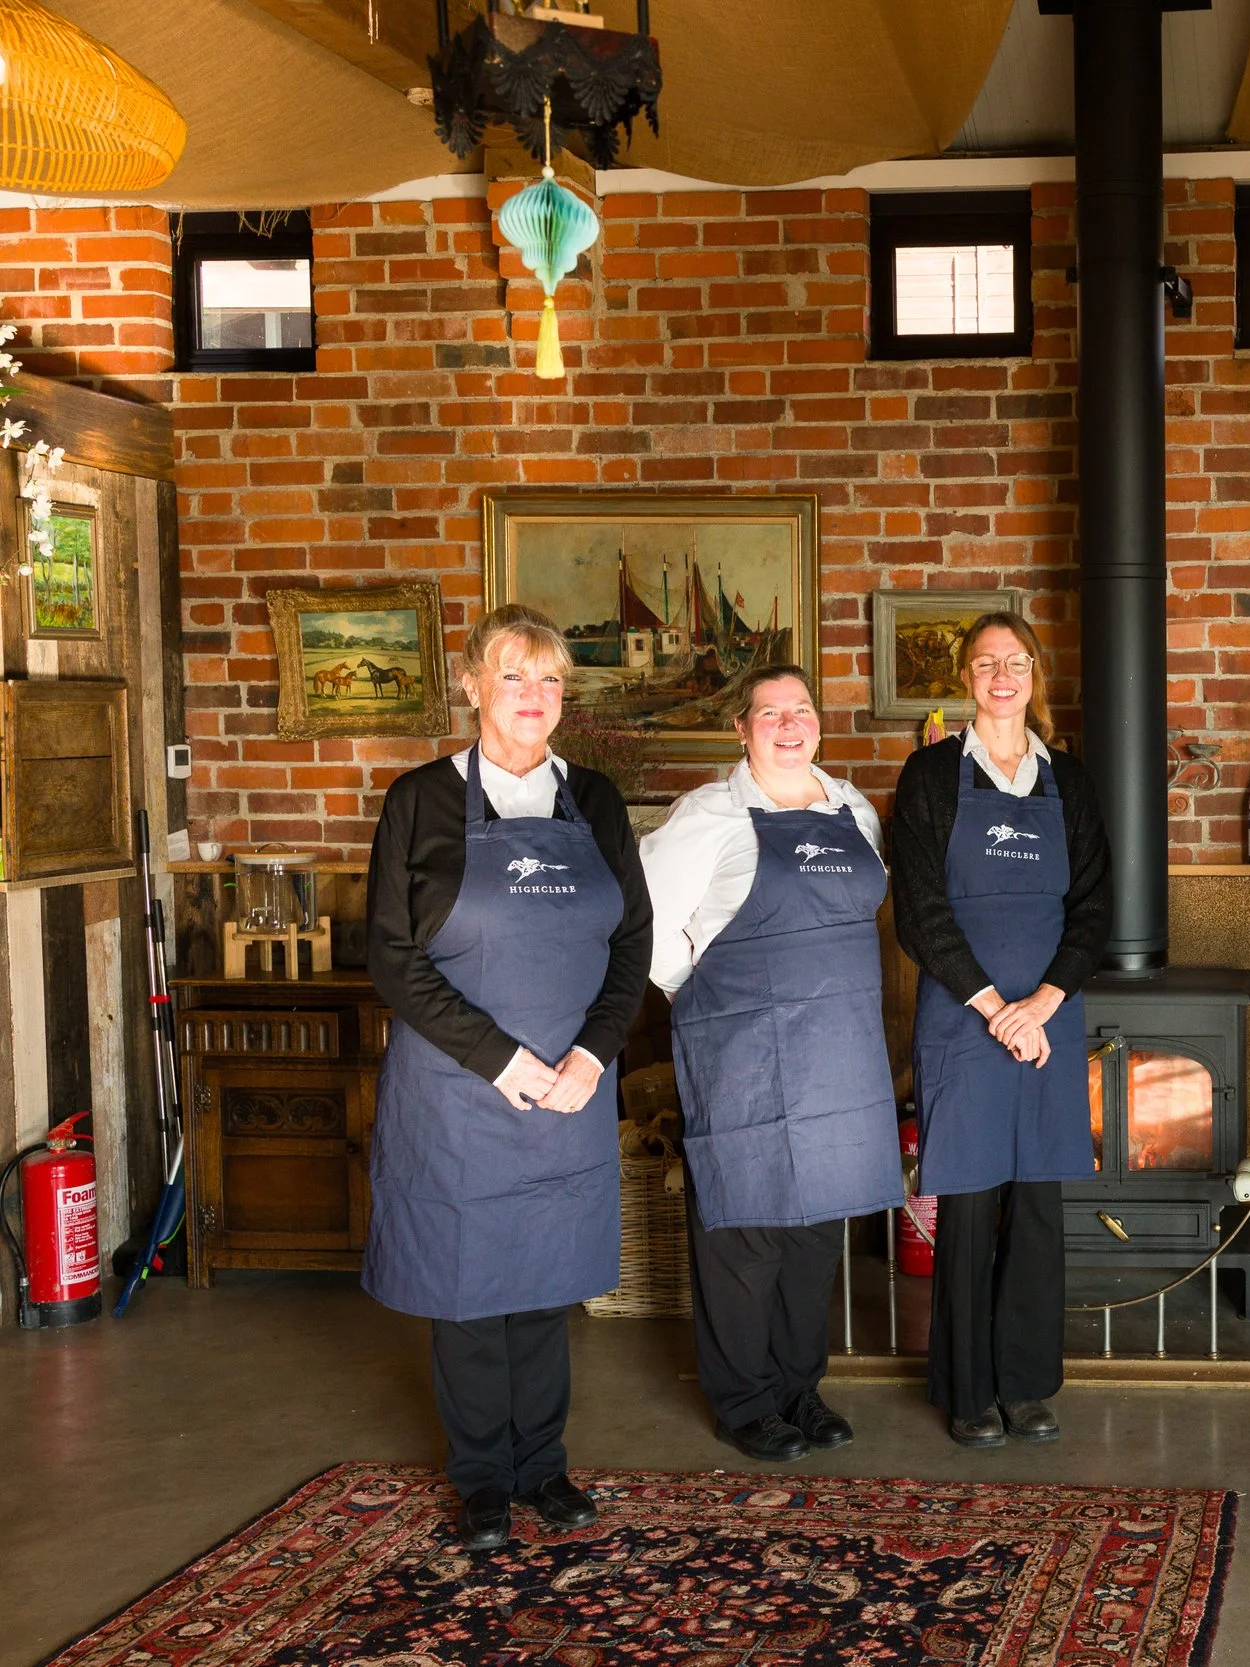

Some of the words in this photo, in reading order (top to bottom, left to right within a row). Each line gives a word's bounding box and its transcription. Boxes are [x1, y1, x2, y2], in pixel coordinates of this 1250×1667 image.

[985, 848, 1040, 861] HIGHCLERE
[799, 865, 853, 873] HIGHCLERE
[509, 885, 577, 894] HIGHCLERE
[62, 1187, 96, 1205] Foam
